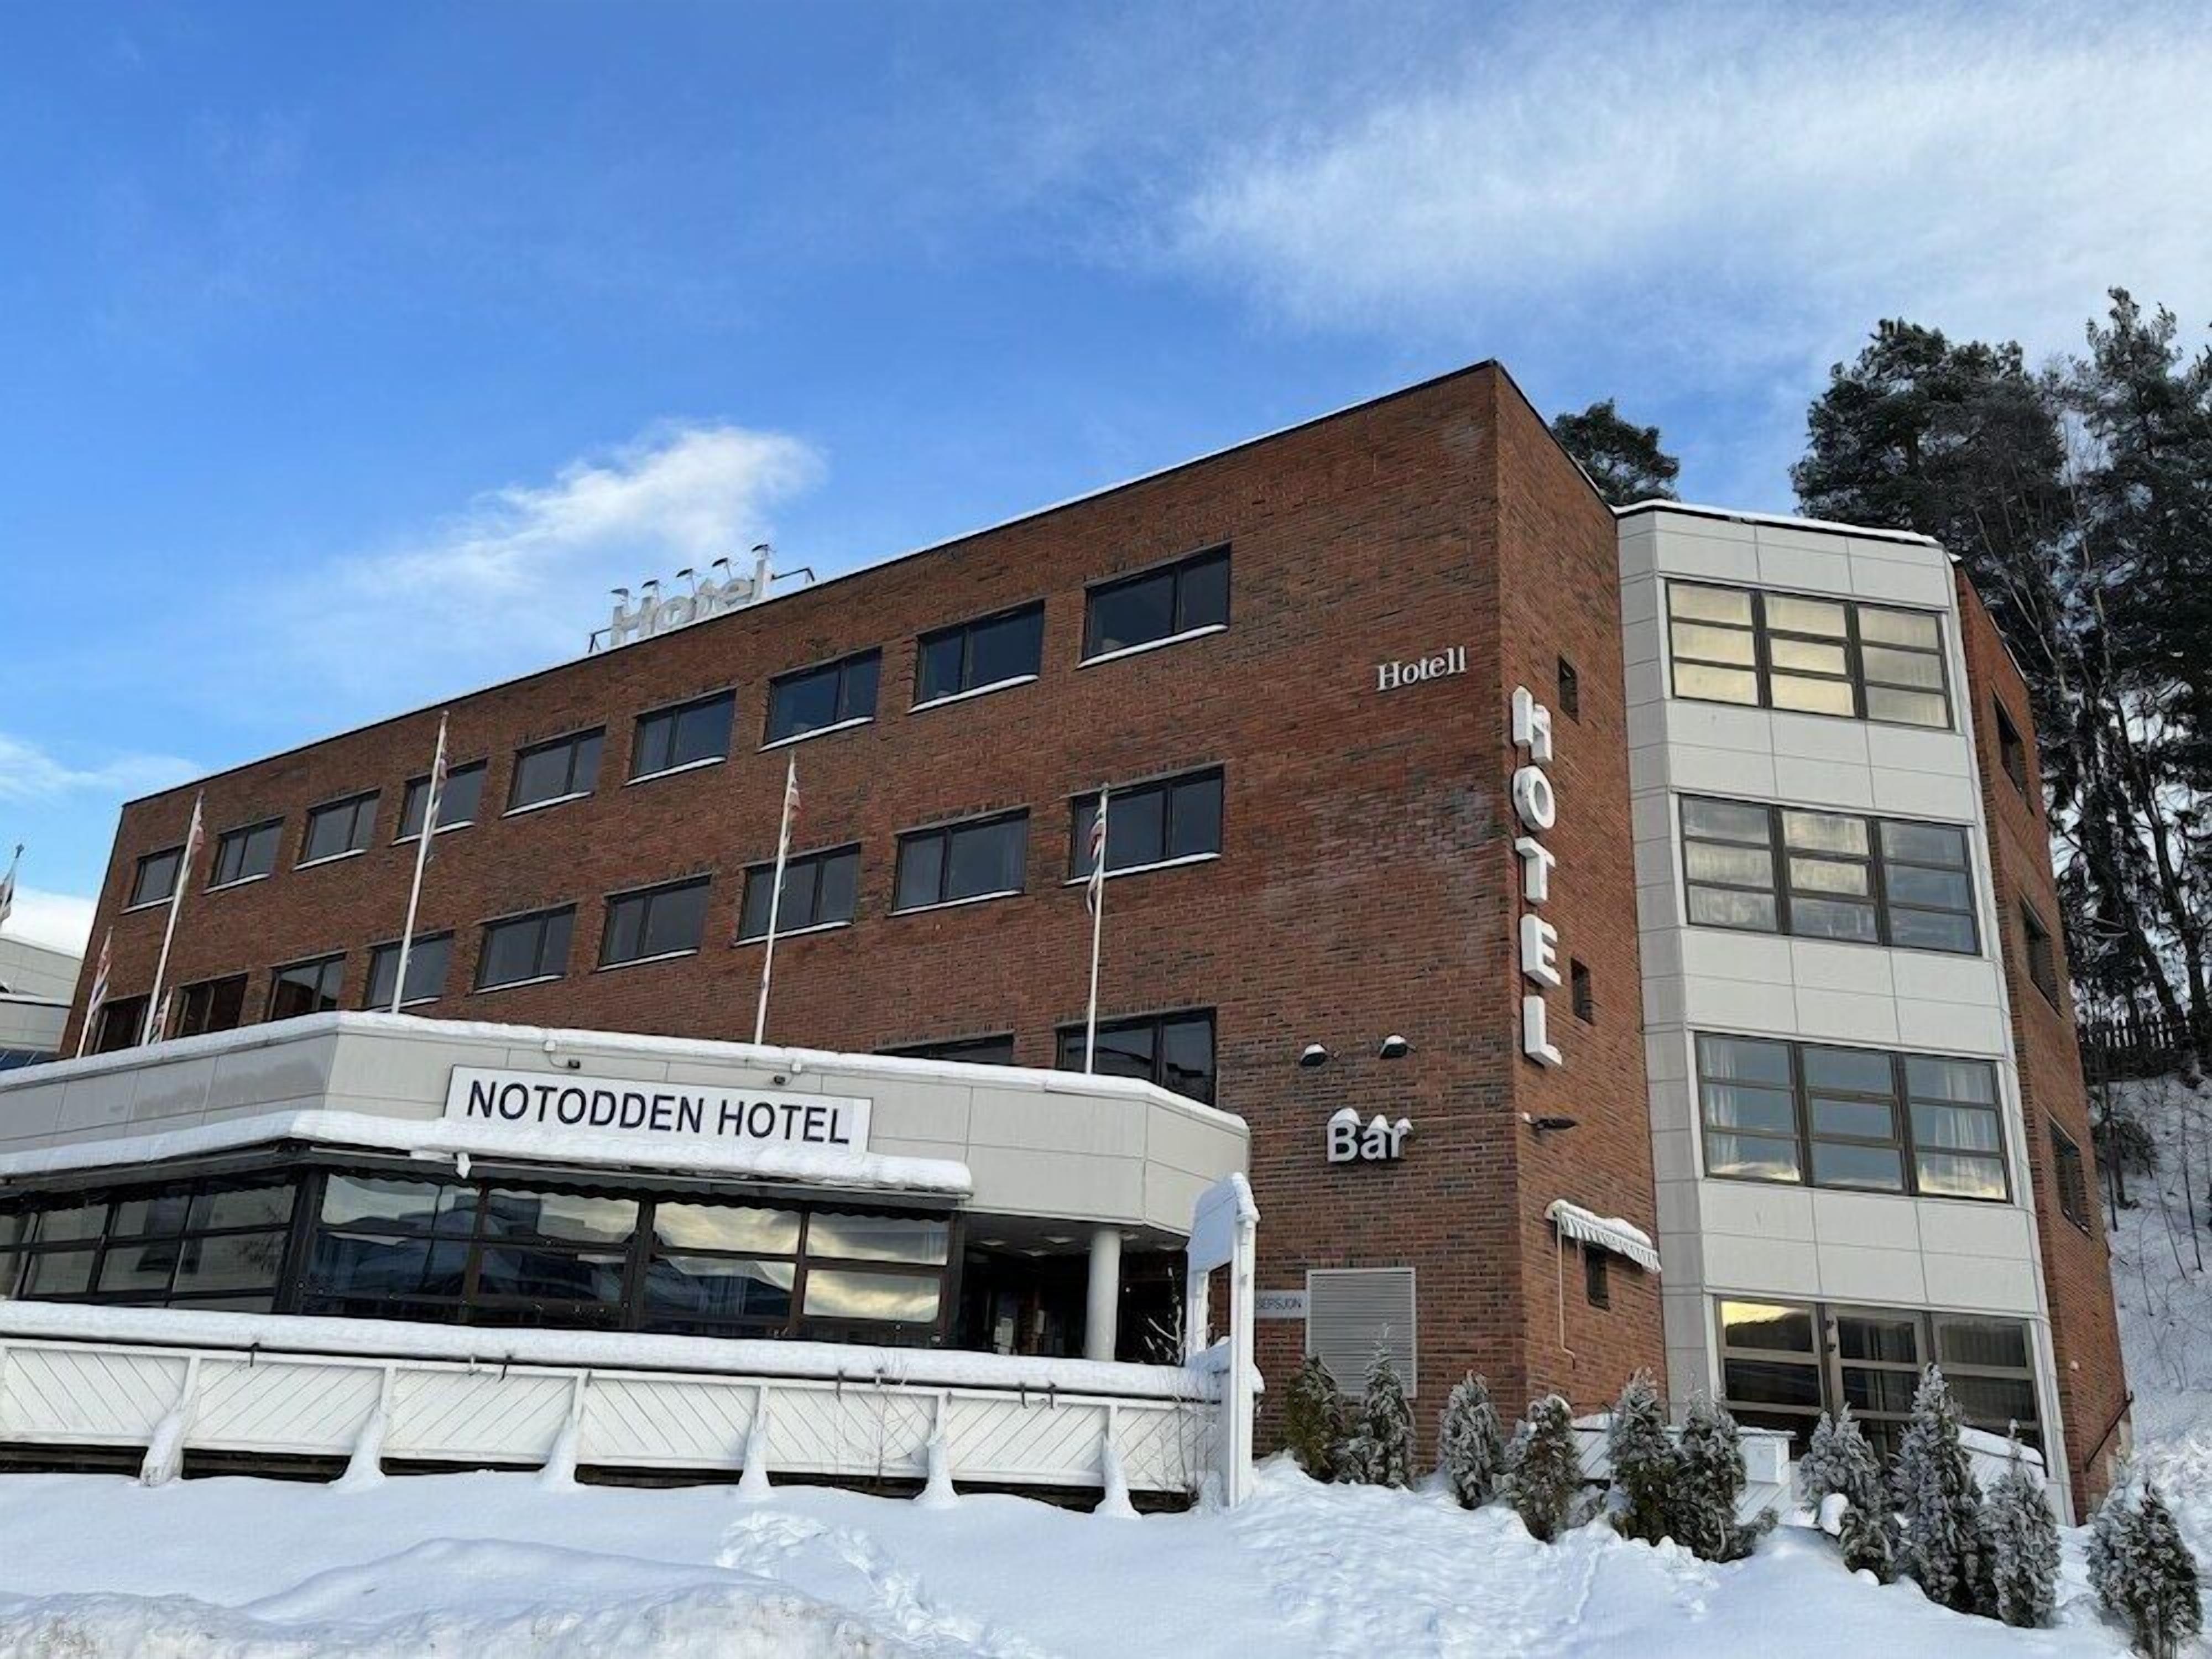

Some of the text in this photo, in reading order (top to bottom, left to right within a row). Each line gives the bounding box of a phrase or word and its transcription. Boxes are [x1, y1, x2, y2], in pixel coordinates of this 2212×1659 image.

[611, 559, 774, 645] Hotel
[1376, 646, 1467, 691] Hotell
[1512, 686, 1562, 1065] HOTEL
[467, 1081, 850, 1144] NOTODDEN HOTEL
[1327, 1119, 1409, 1161] Bar
